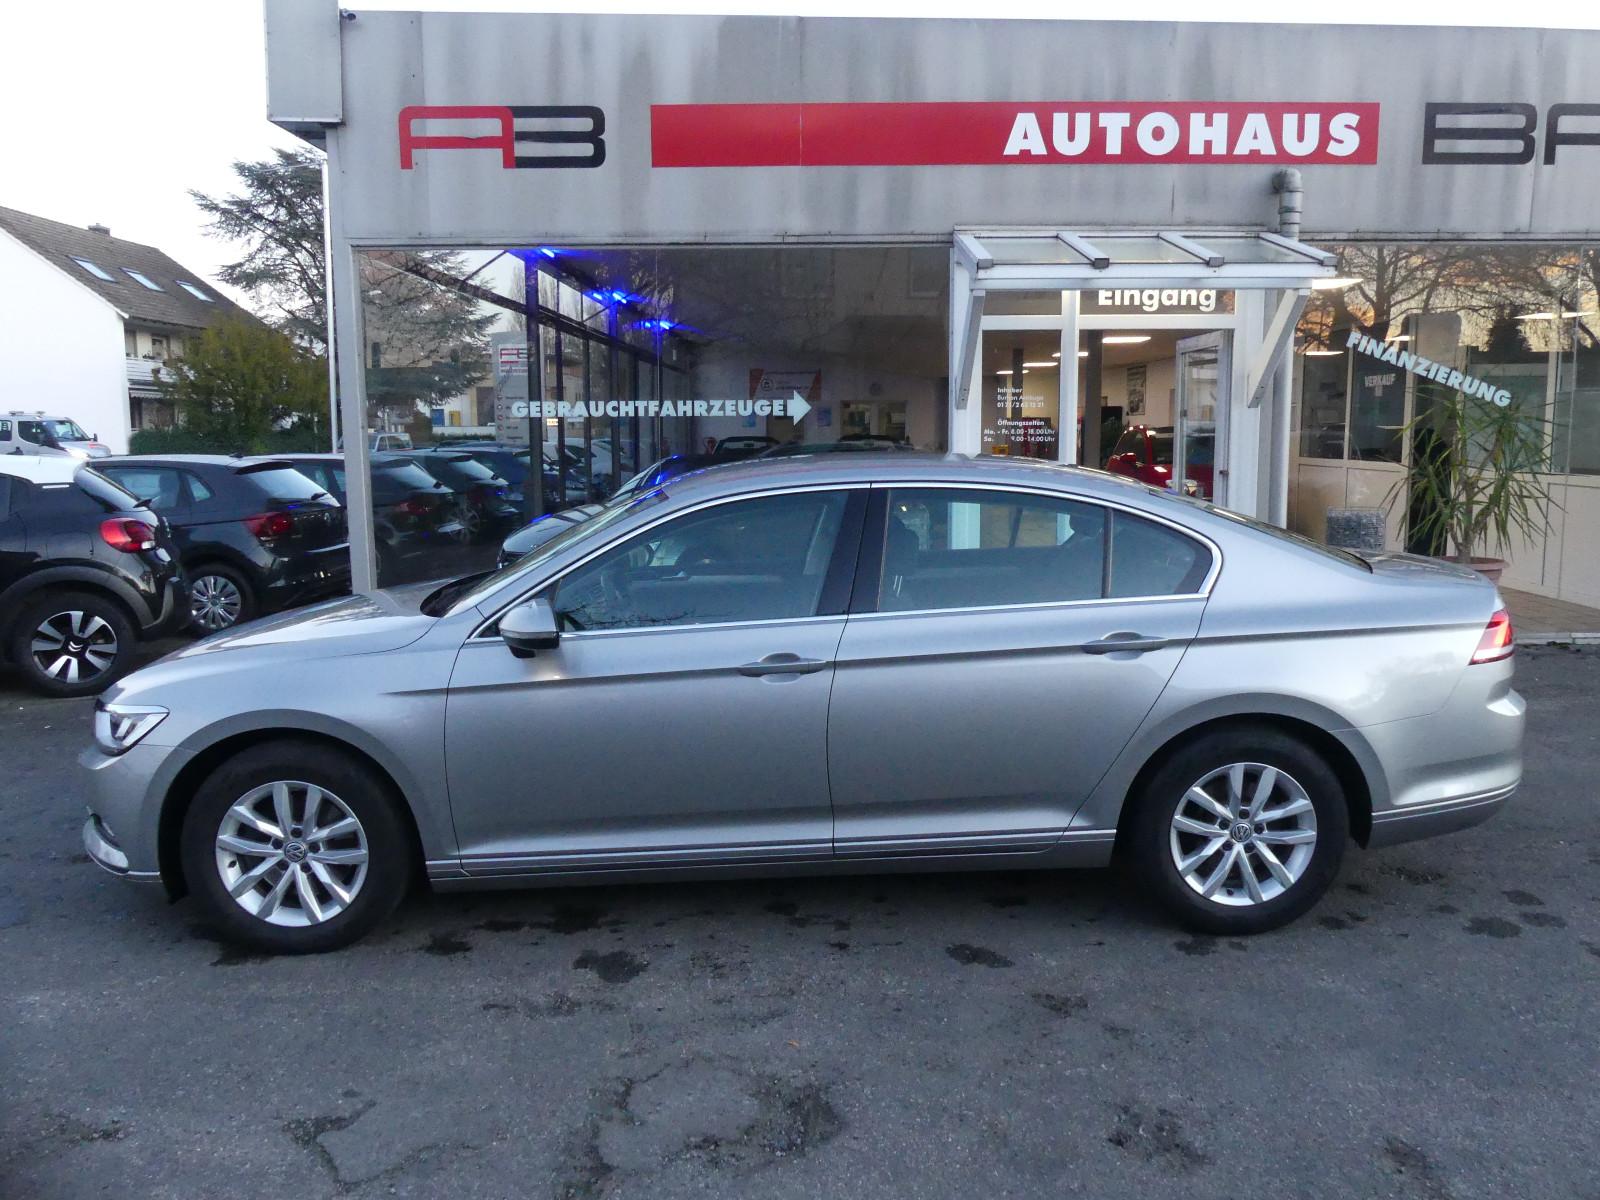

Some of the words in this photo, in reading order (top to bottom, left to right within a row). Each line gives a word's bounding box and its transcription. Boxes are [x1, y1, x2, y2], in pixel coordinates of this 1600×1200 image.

[398, 105, 606, 170] AB
[1003, 111, 1361, 156] AUTOHAUS
[1098, 289, 1217, 312] Eingang
[1346, 332, 1512, 407] FINANZIERUNG
[1364, 373, 1396, 387] VERKAUF
[511, 400, 784, 418] GEBRAUCHTFAHRZEUGE
